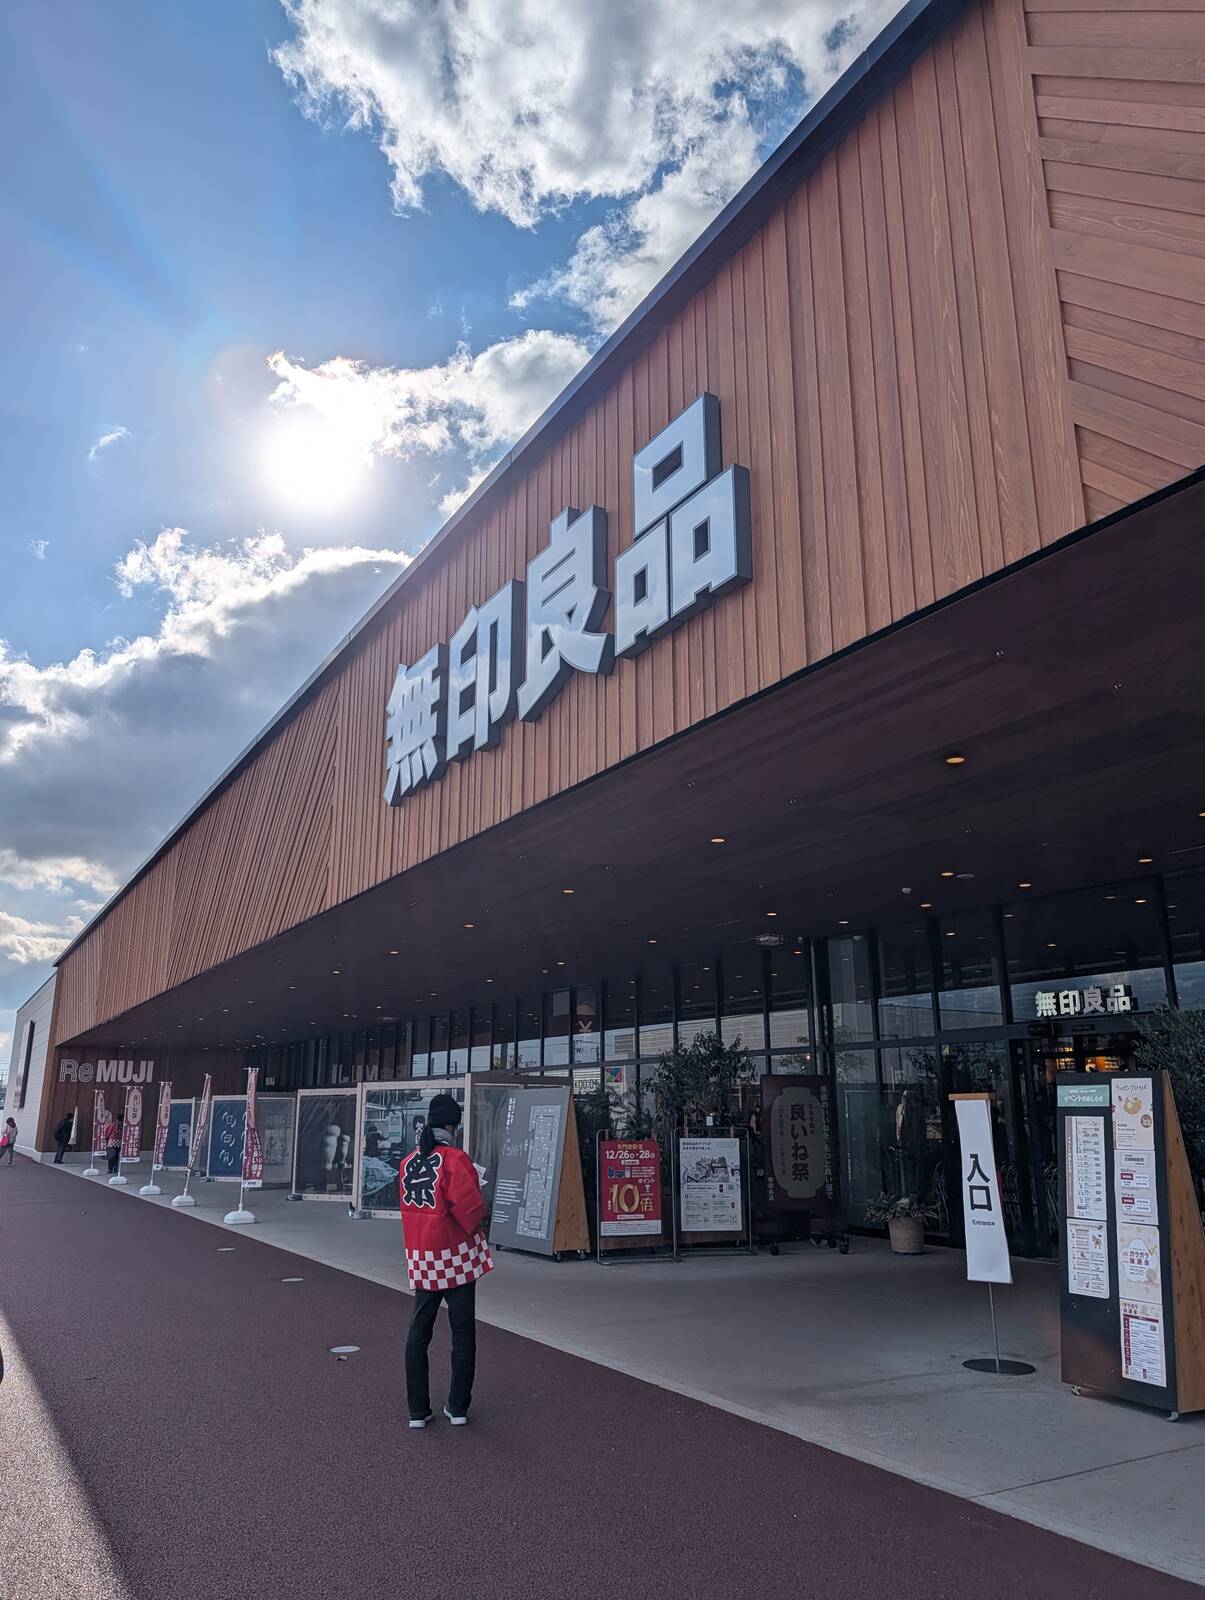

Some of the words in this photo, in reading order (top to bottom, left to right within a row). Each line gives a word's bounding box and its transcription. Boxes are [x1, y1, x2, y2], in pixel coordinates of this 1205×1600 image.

[384, 391, 752, 807] 無印良品
[1035, 984, 1134, 1018] 無印良品
[790, 1102, 809, 1183] 良いね祭
[402, 1151, 442, 1209] 祭
[606, 1184, 640, 1213] 10
[640, 1197, 654, 1212] 倍
[967, 1154, 992, 1212] 入口
